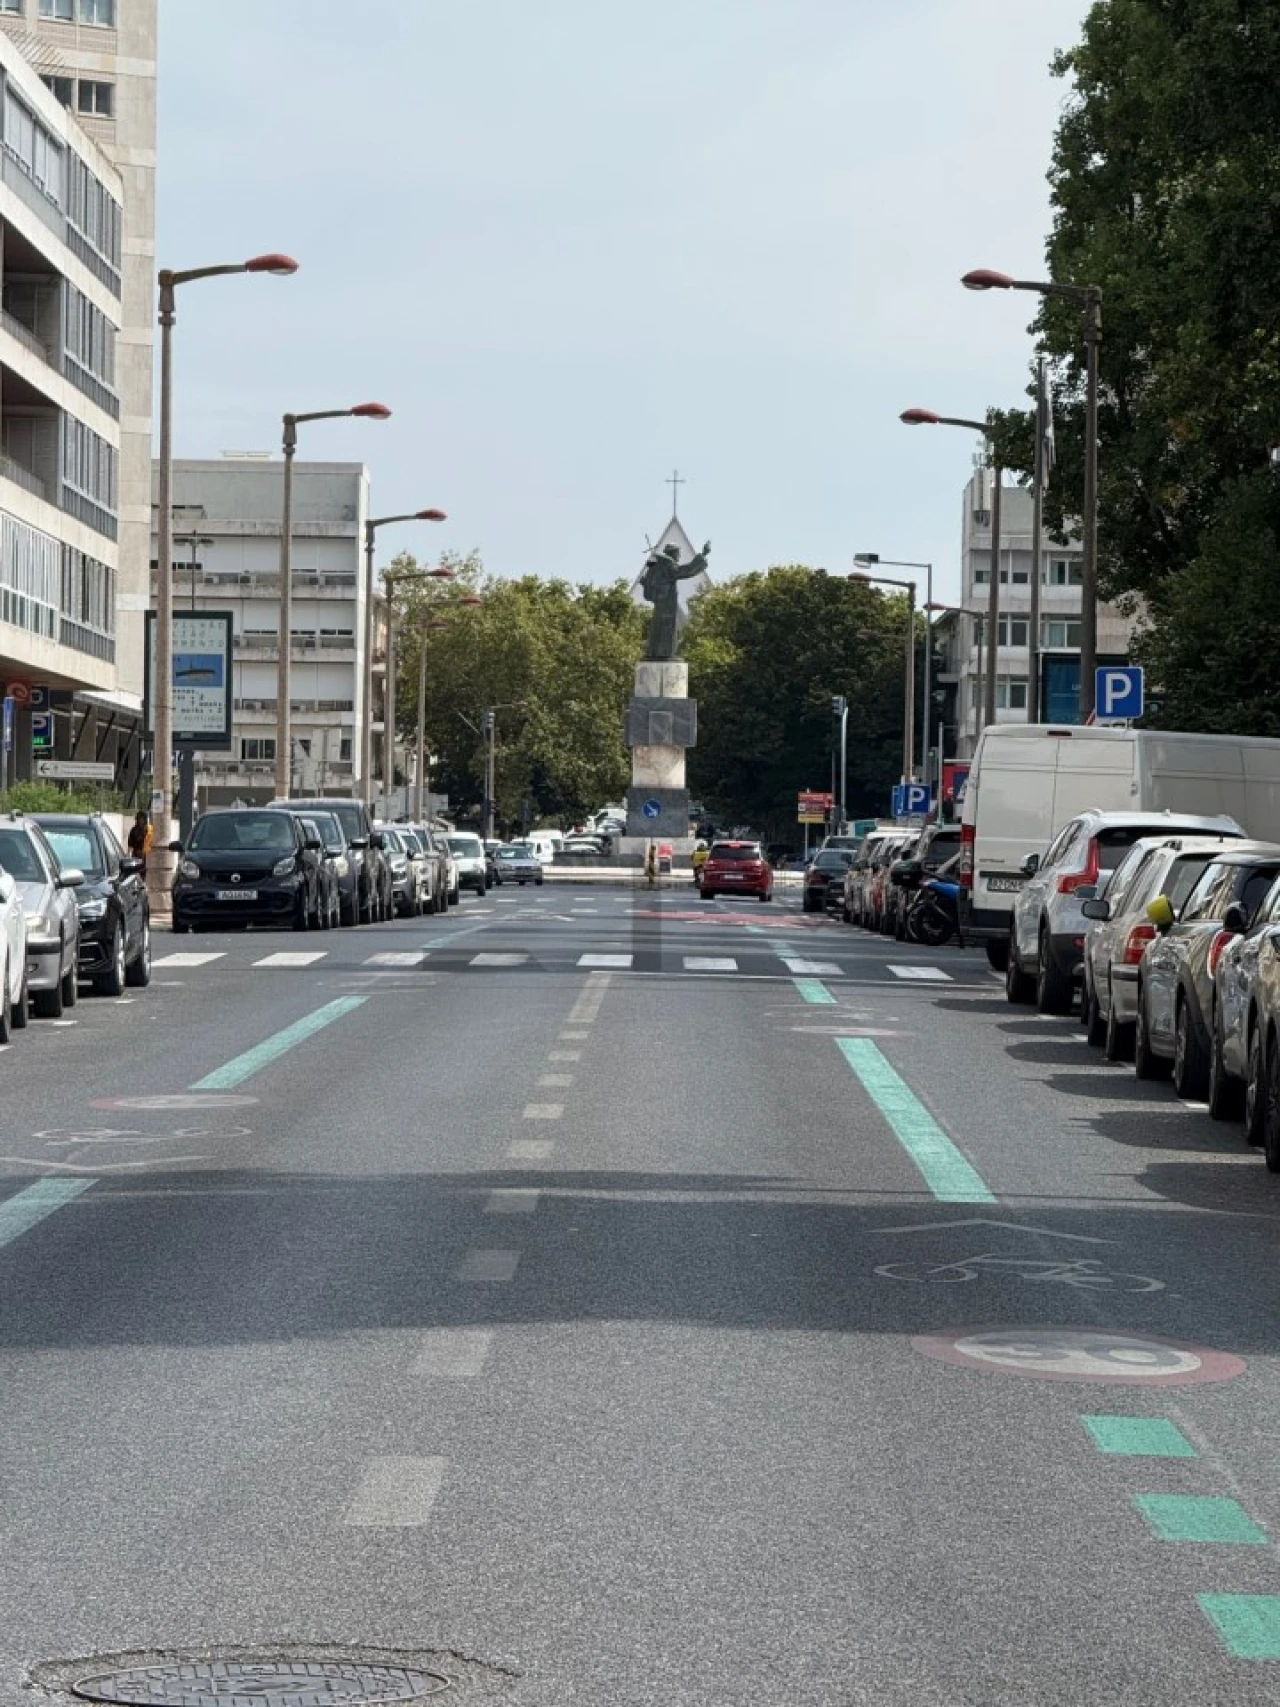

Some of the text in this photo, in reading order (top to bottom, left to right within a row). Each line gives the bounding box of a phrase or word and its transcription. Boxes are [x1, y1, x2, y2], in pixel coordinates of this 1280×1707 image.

[1105, 673, 1132, 714] P
[907, 787, 925, 810] P
[976, 1337, 1183, 1367] 30
